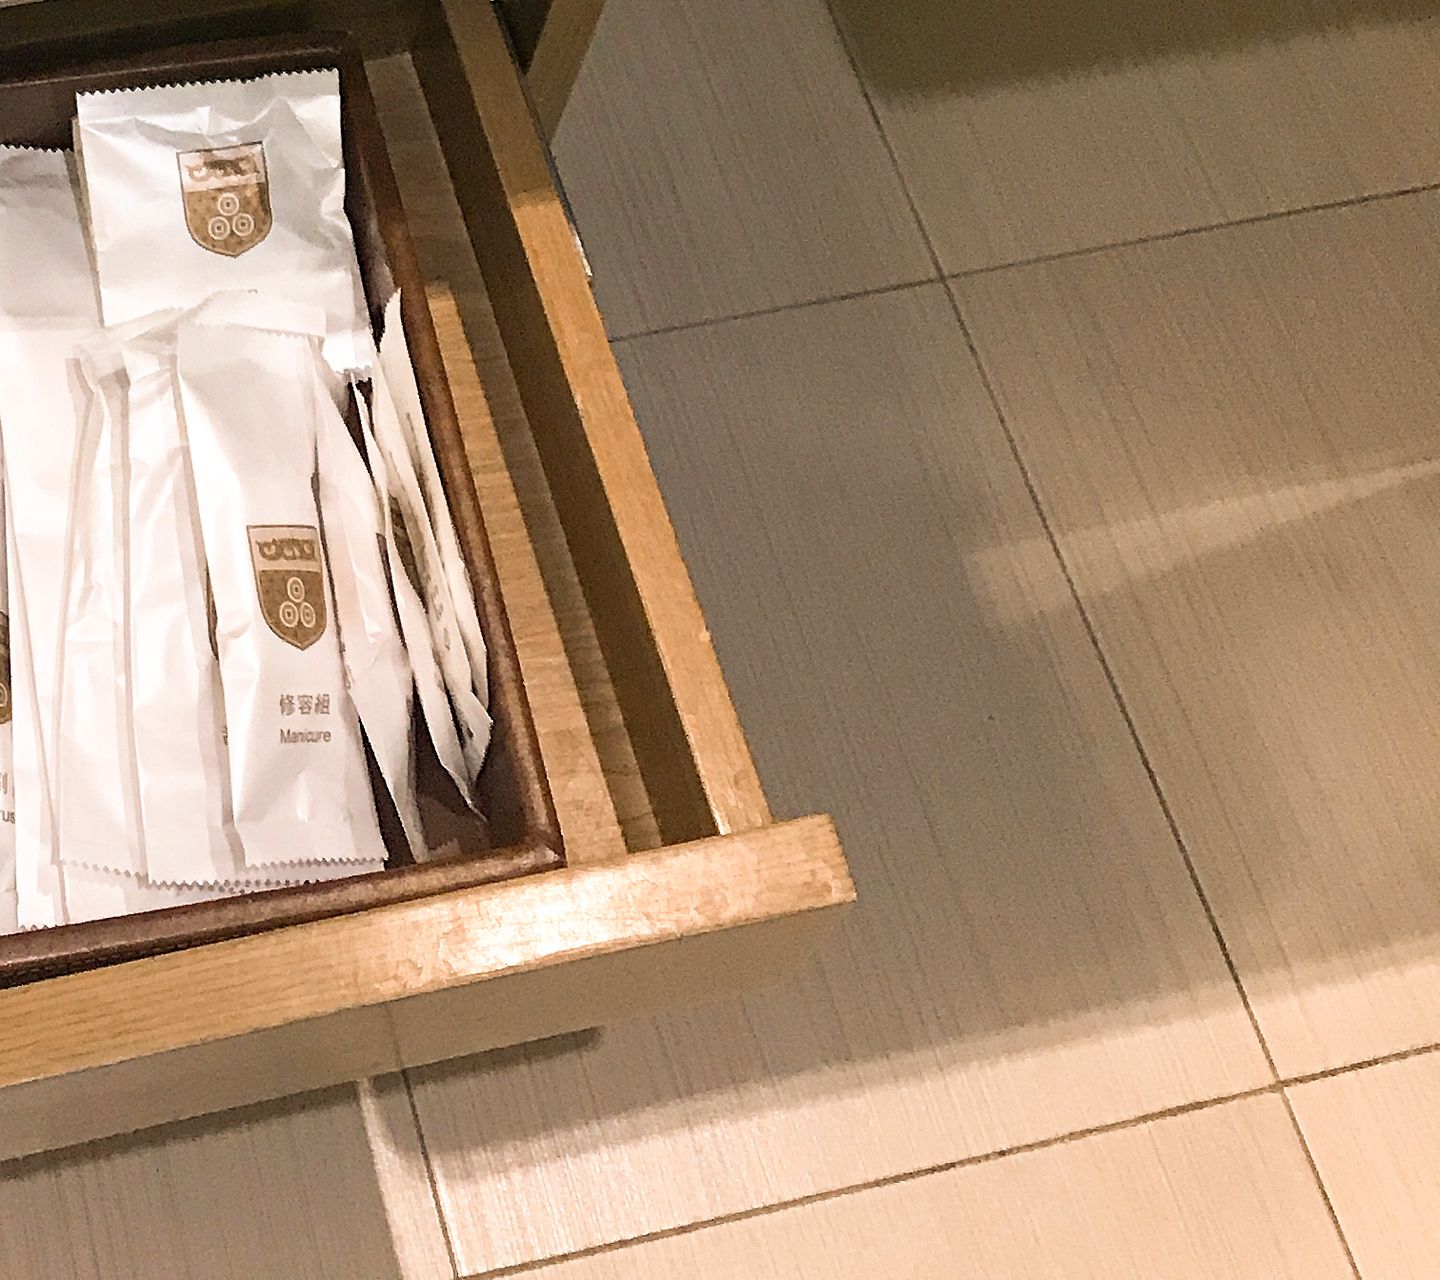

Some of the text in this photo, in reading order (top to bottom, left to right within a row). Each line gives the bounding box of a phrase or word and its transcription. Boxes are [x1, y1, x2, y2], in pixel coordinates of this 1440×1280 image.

[280, 694, 330, 715] 修容組
[280, 728, 332, 744] Manicure
